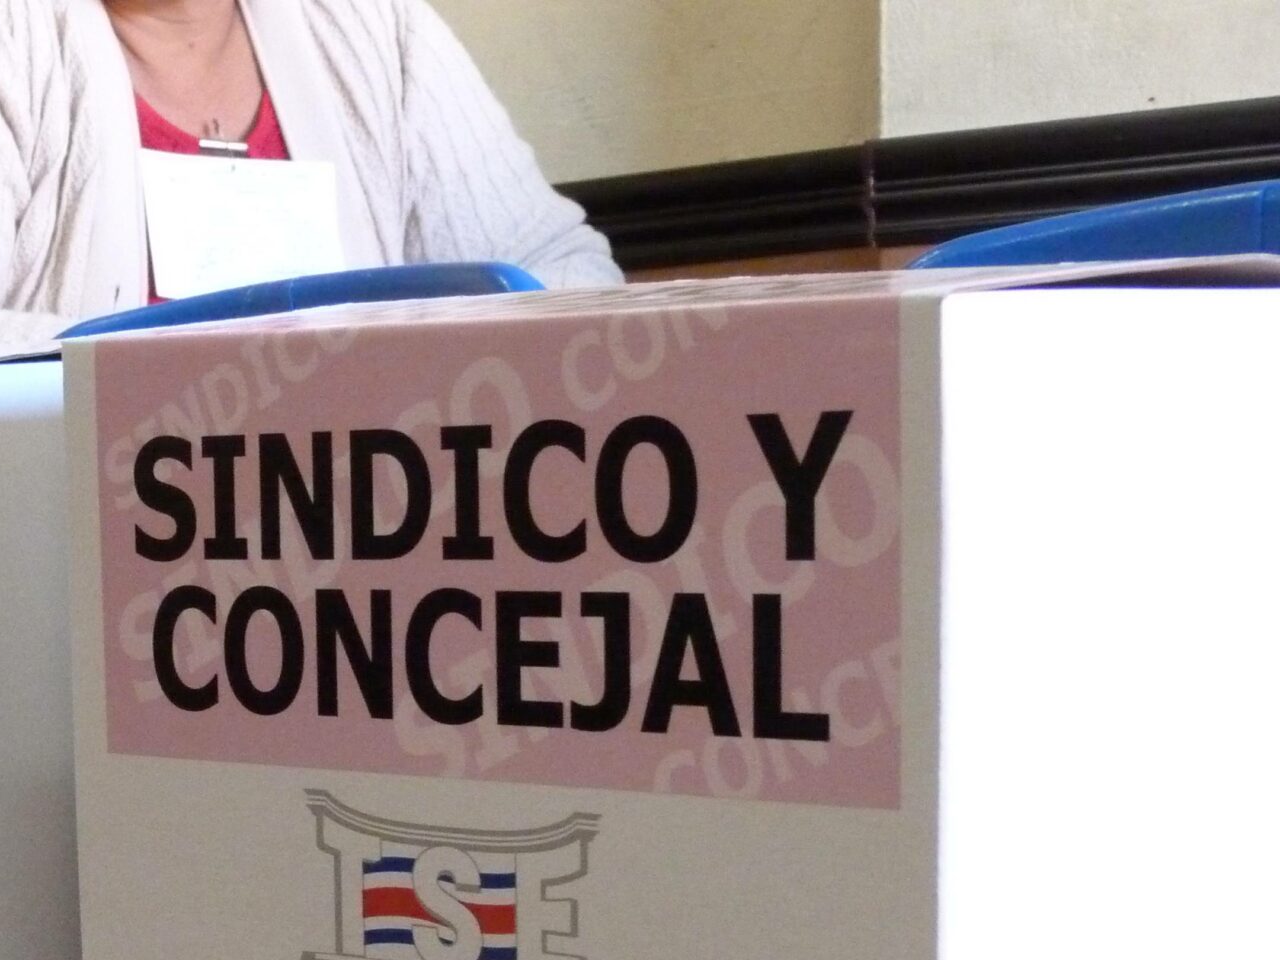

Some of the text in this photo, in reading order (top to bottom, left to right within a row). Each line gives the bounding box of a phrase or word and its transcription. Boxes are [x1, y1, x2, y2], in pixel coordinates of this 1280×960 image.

[133, 410, 854, 564] SINDICO Y
[152, 585, 830, 742] CONCEJAL
